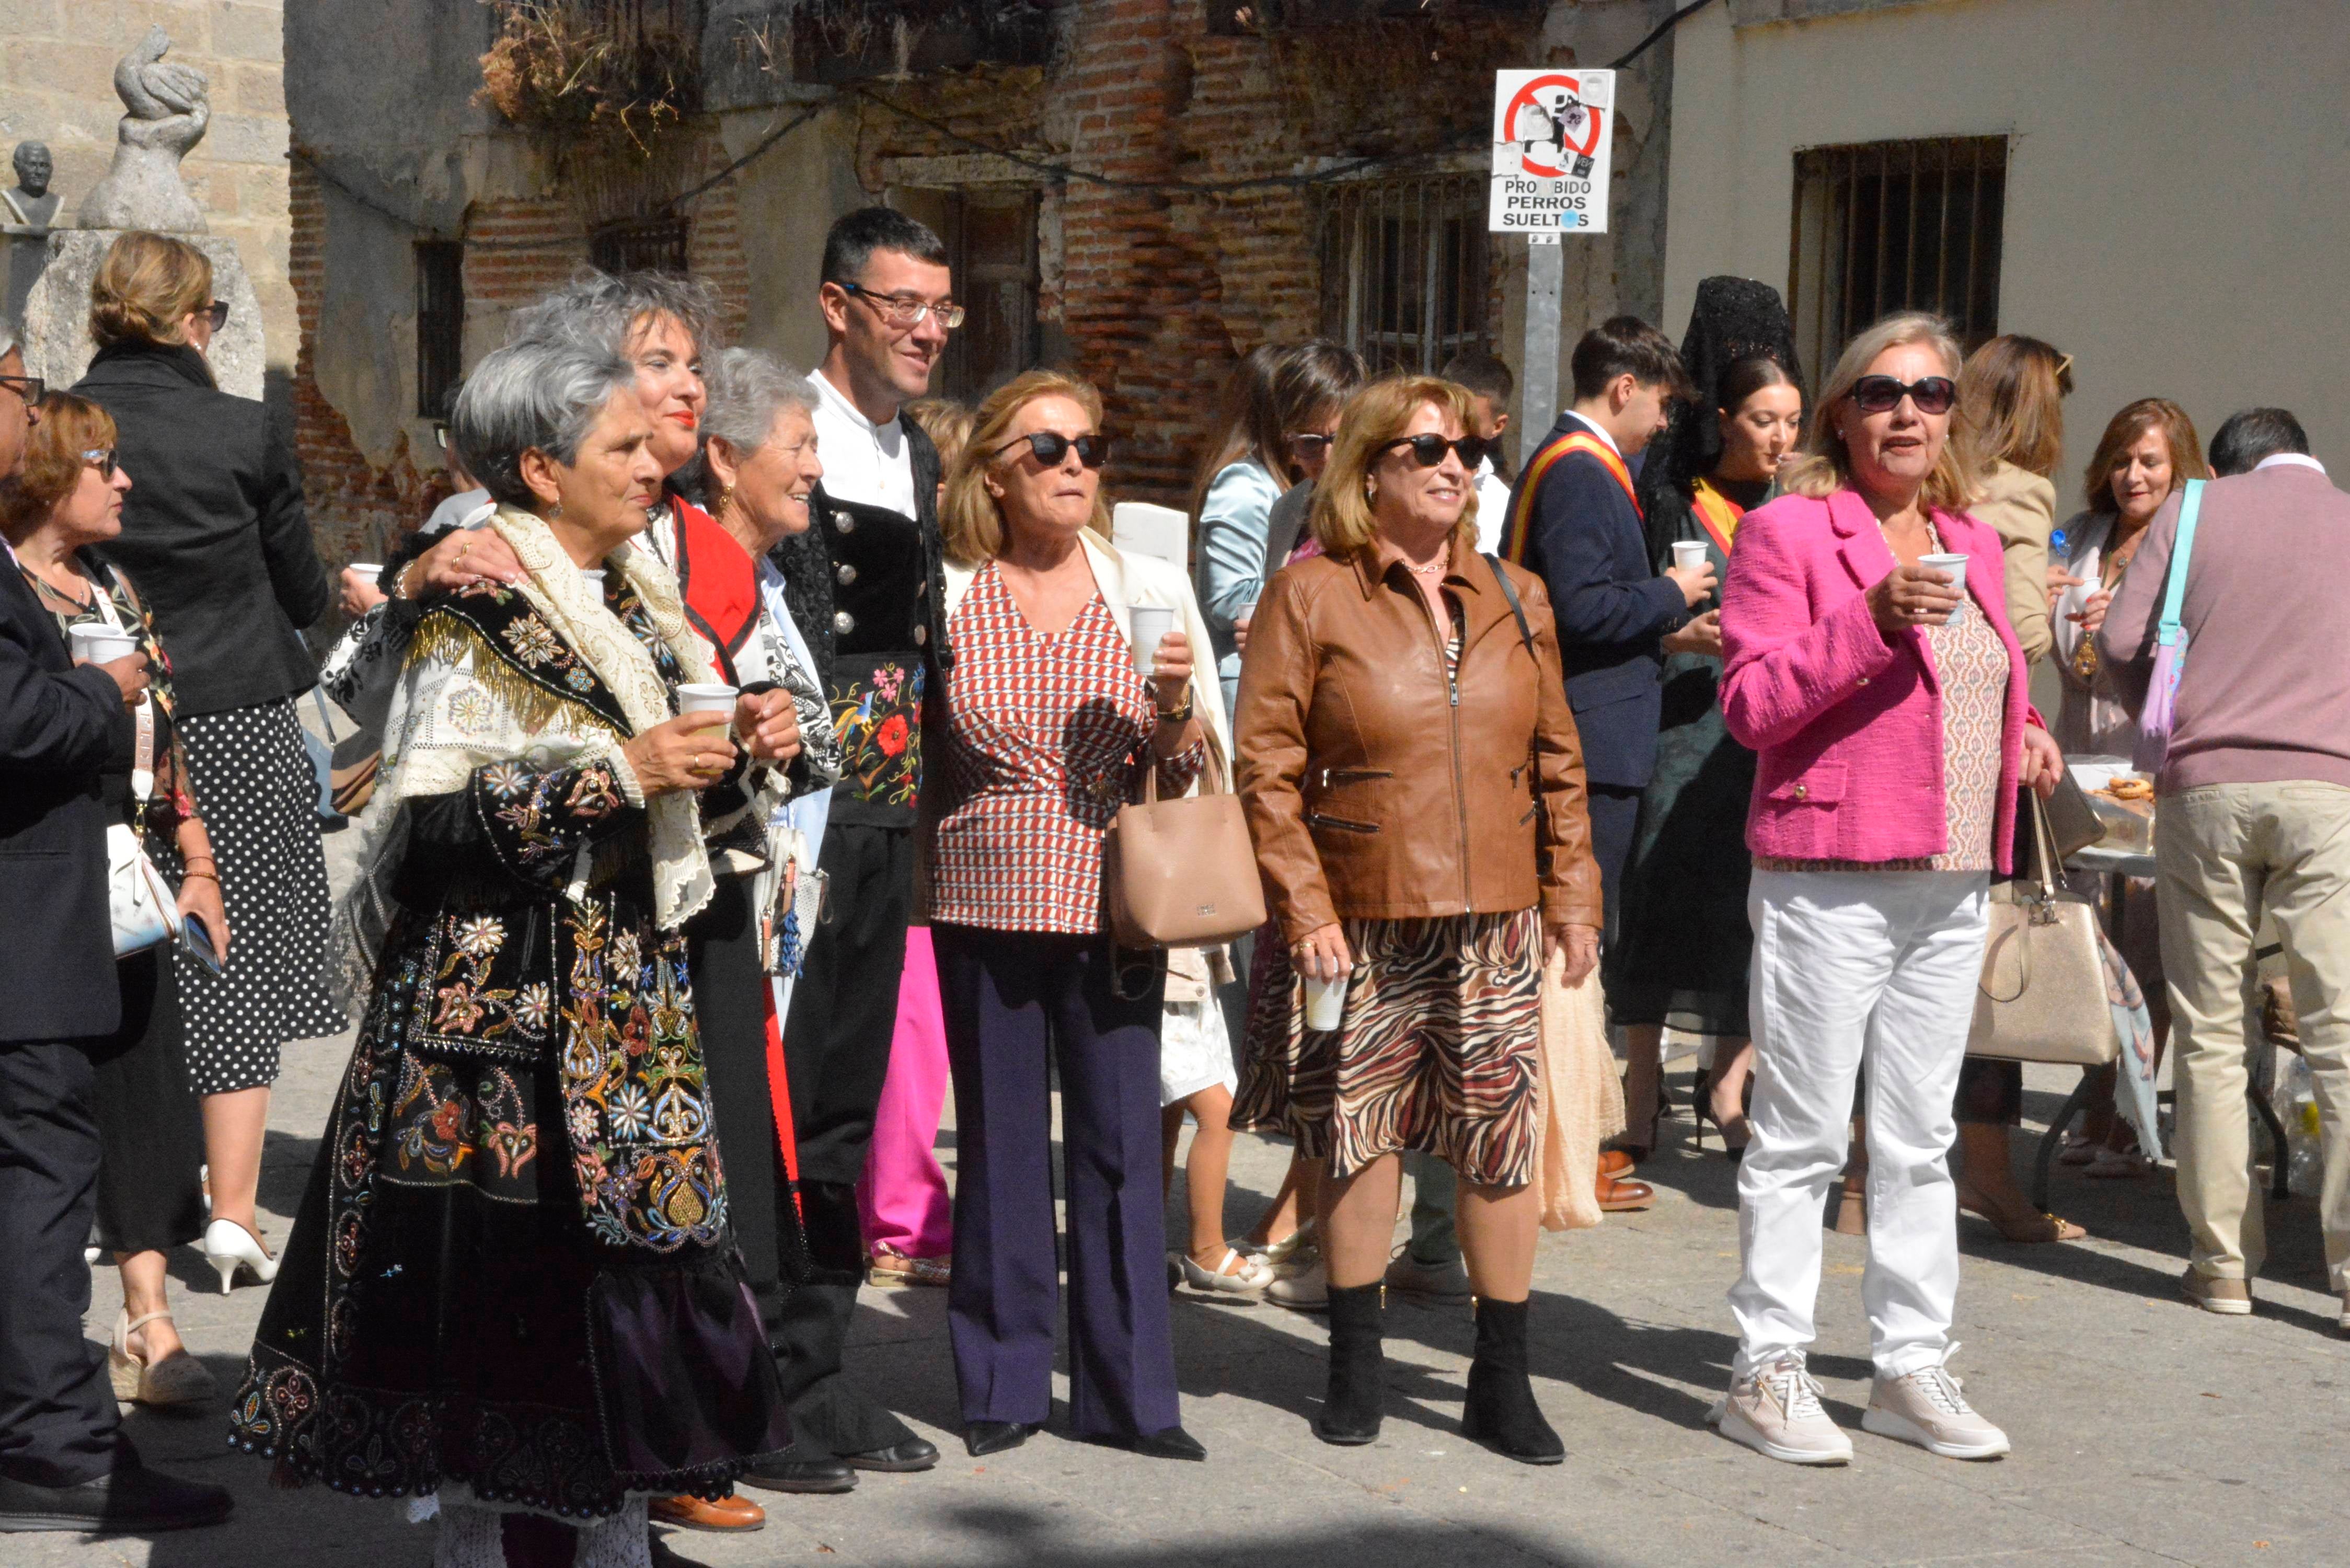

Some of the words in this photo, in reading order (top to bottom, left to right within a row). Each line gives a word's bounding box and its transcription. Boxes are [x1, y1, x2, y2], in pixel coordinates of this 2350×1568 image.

[1505, 181, 1591, 194] PROBIDO
[1507, 197, 1586, 209] PERROS
[1503, 213, 1588, 226] SUELTS
